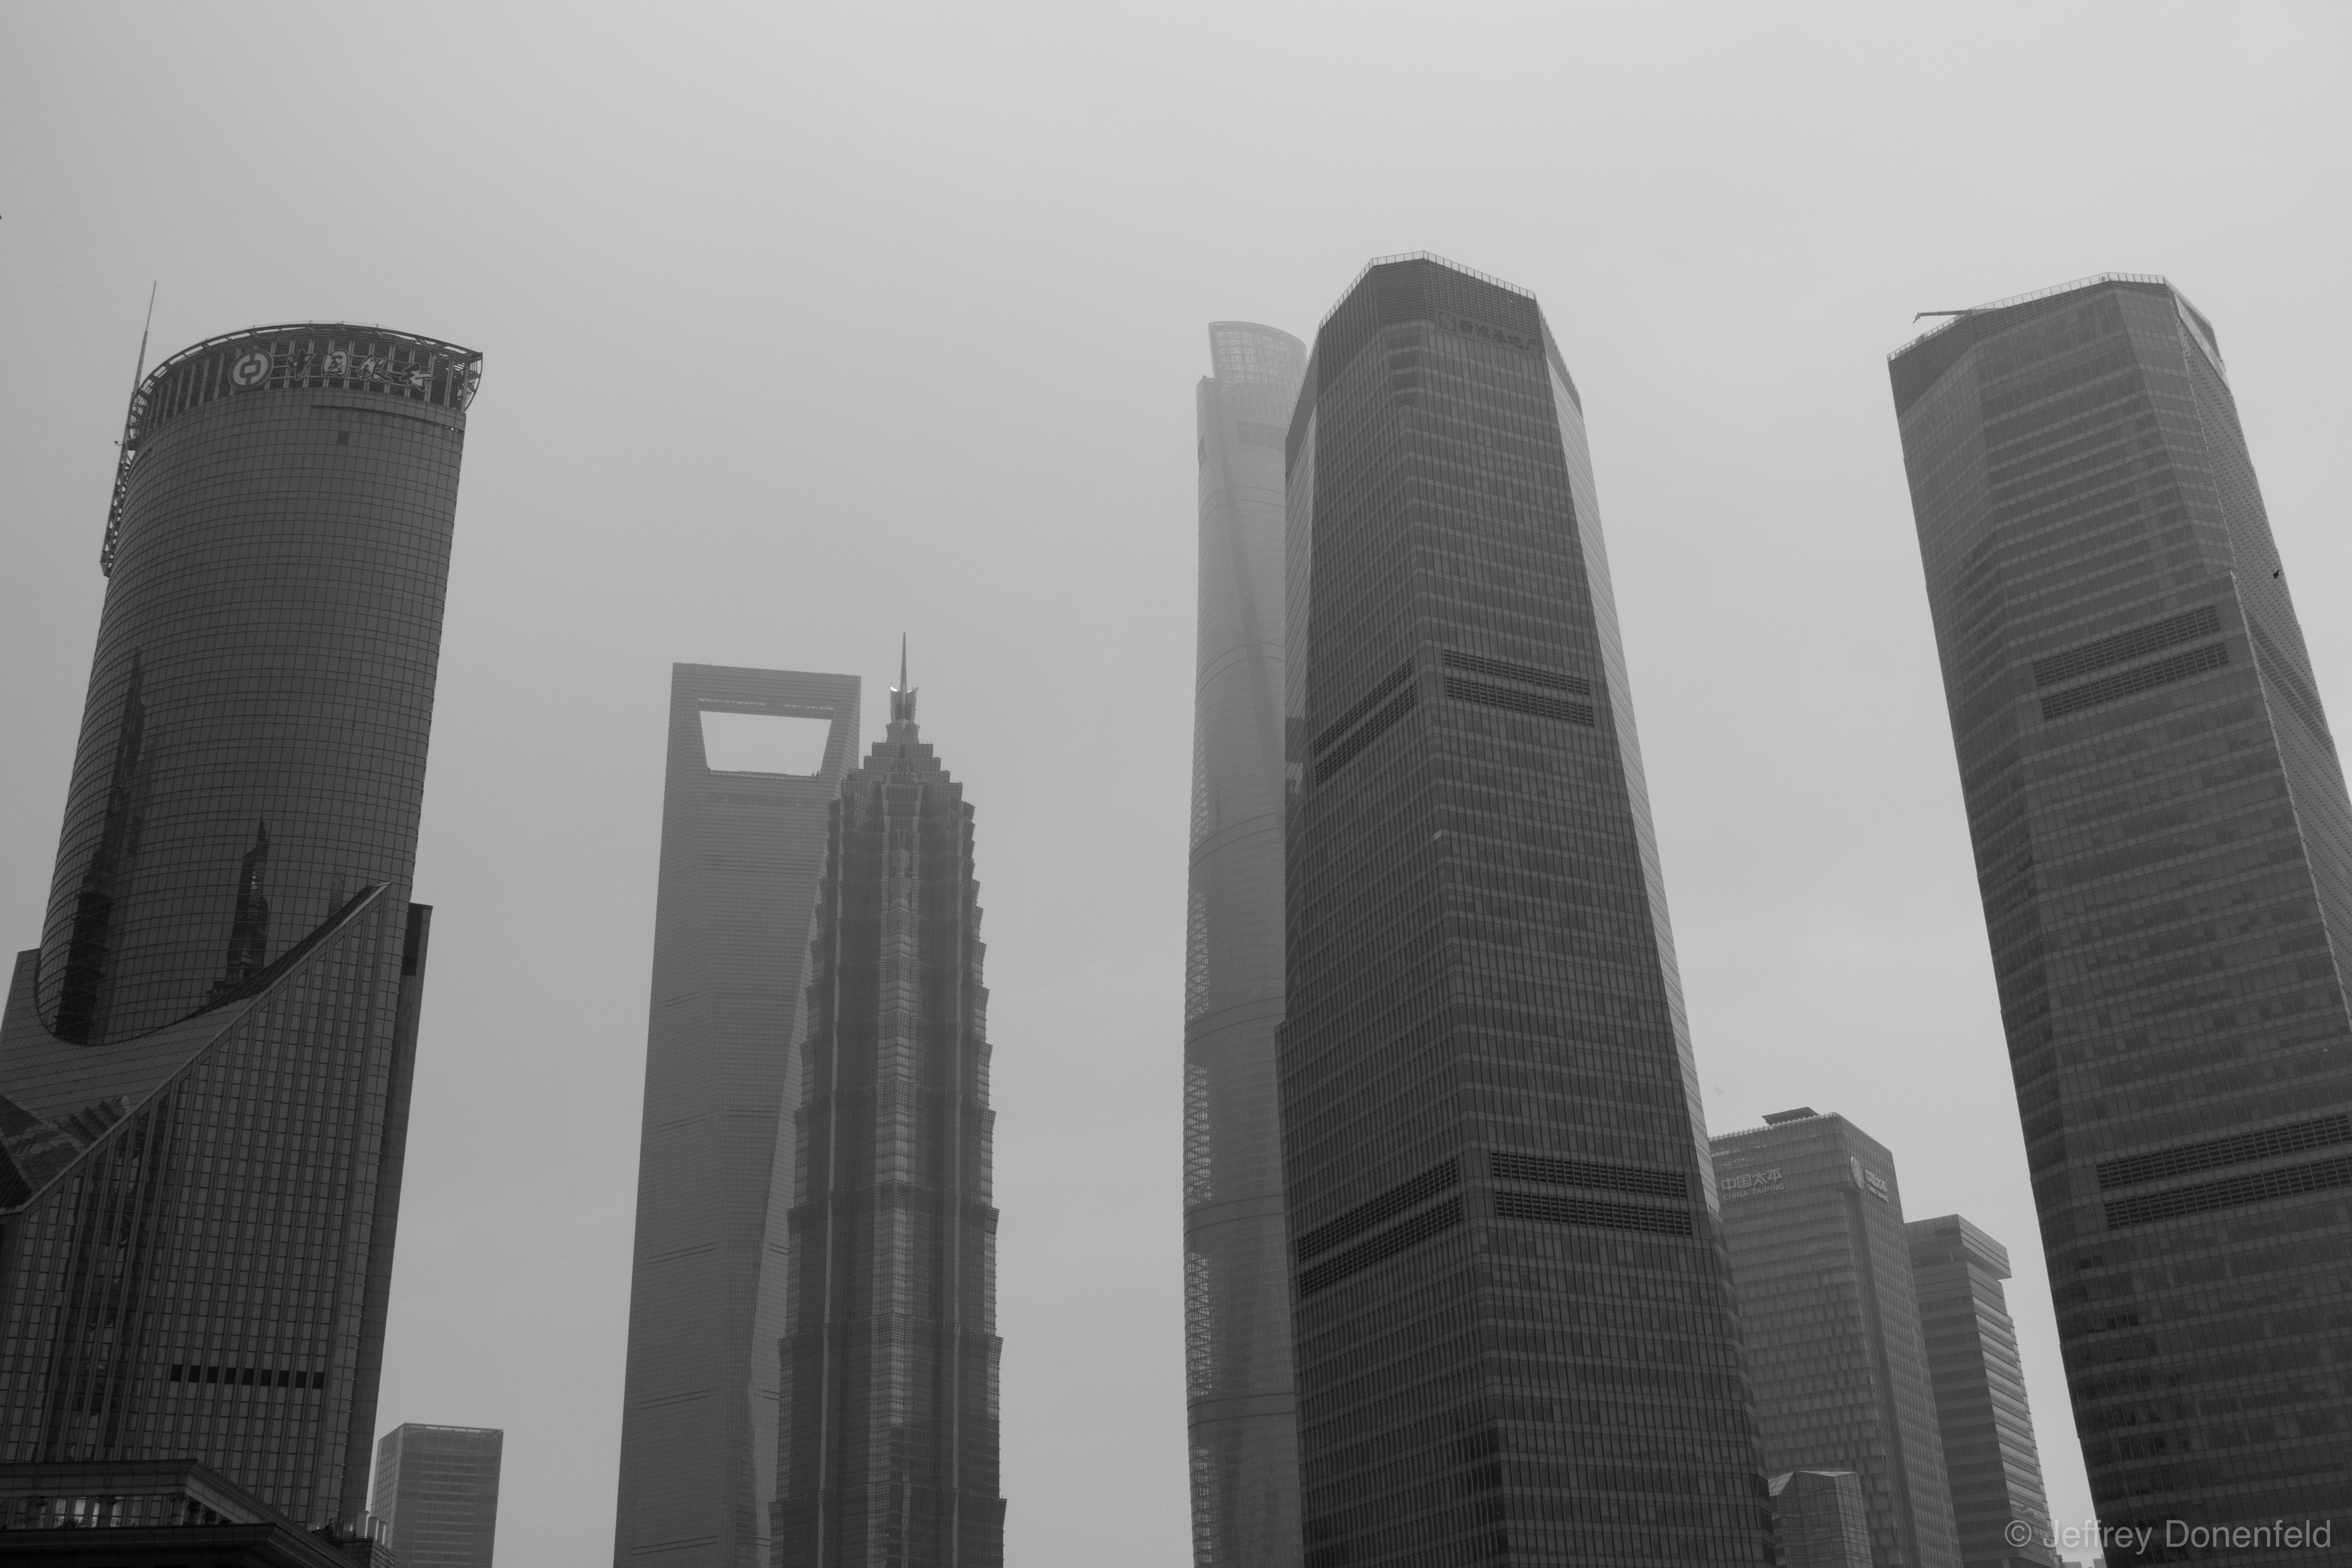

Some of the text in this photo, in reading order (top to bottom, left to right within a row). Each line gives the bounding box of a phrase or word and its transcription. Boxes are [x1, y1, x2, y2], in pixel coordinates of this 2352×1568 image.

[1459, 319, 1537, 350] 新鸿基地产
[1721, 1168, 1782, 1191] 中国太平
[1723, 1183, 1784, 1201] CHINA TAIPING
